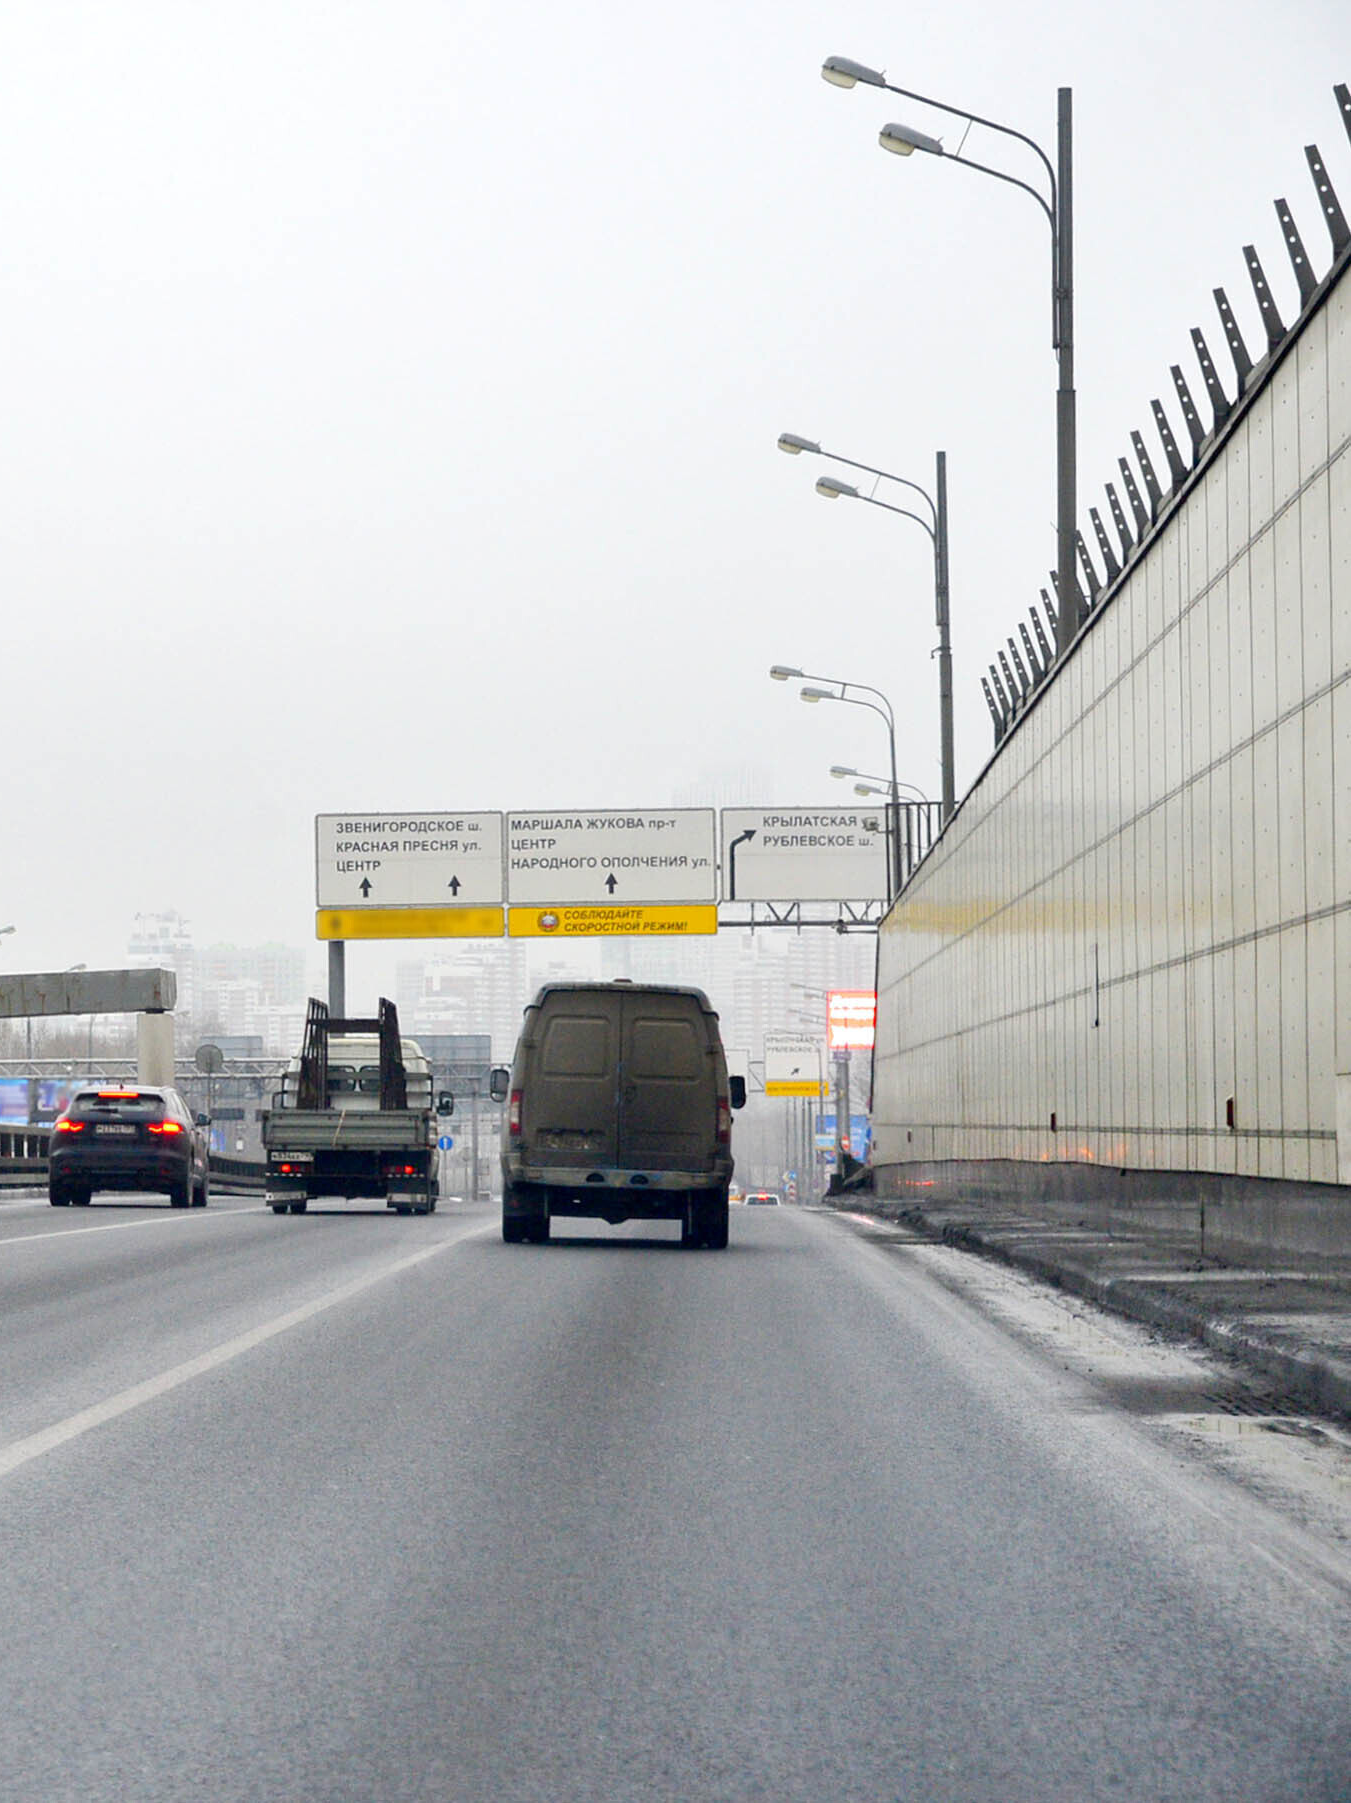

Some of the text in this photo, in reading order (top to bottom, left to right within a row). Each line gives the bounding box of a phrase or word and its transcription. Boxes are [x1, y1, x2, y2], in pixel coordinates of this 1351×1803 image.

[336, 820, 482, 834] ЗВЕНИГОРОДСКОЕ ш.
[511, 817, 677, 831] МАРШАЛА ЖУКОВА пр-т
[762, 816, 857, 828] КРЫЛАТСКАЯ
[336, 839, 482, 853] КРАСНАЯ ПРЕСНЯ ул.
[511, 838, 557, 851] ЦЕНТР
[763, 835, 855, 847] РУБЛЕВСКОЕ
[336, 860, 381, 874] ЦЕНТР
[511, 856, 711, 870] НАРОДНОГО ОПОЛЧЕНИЯ ул.
[564, 909, 643, 921] СОБЛЮДАЙТЕ
[564, 921, 688, 933] СКОРОСТНОЙ РЕЖИМ!
